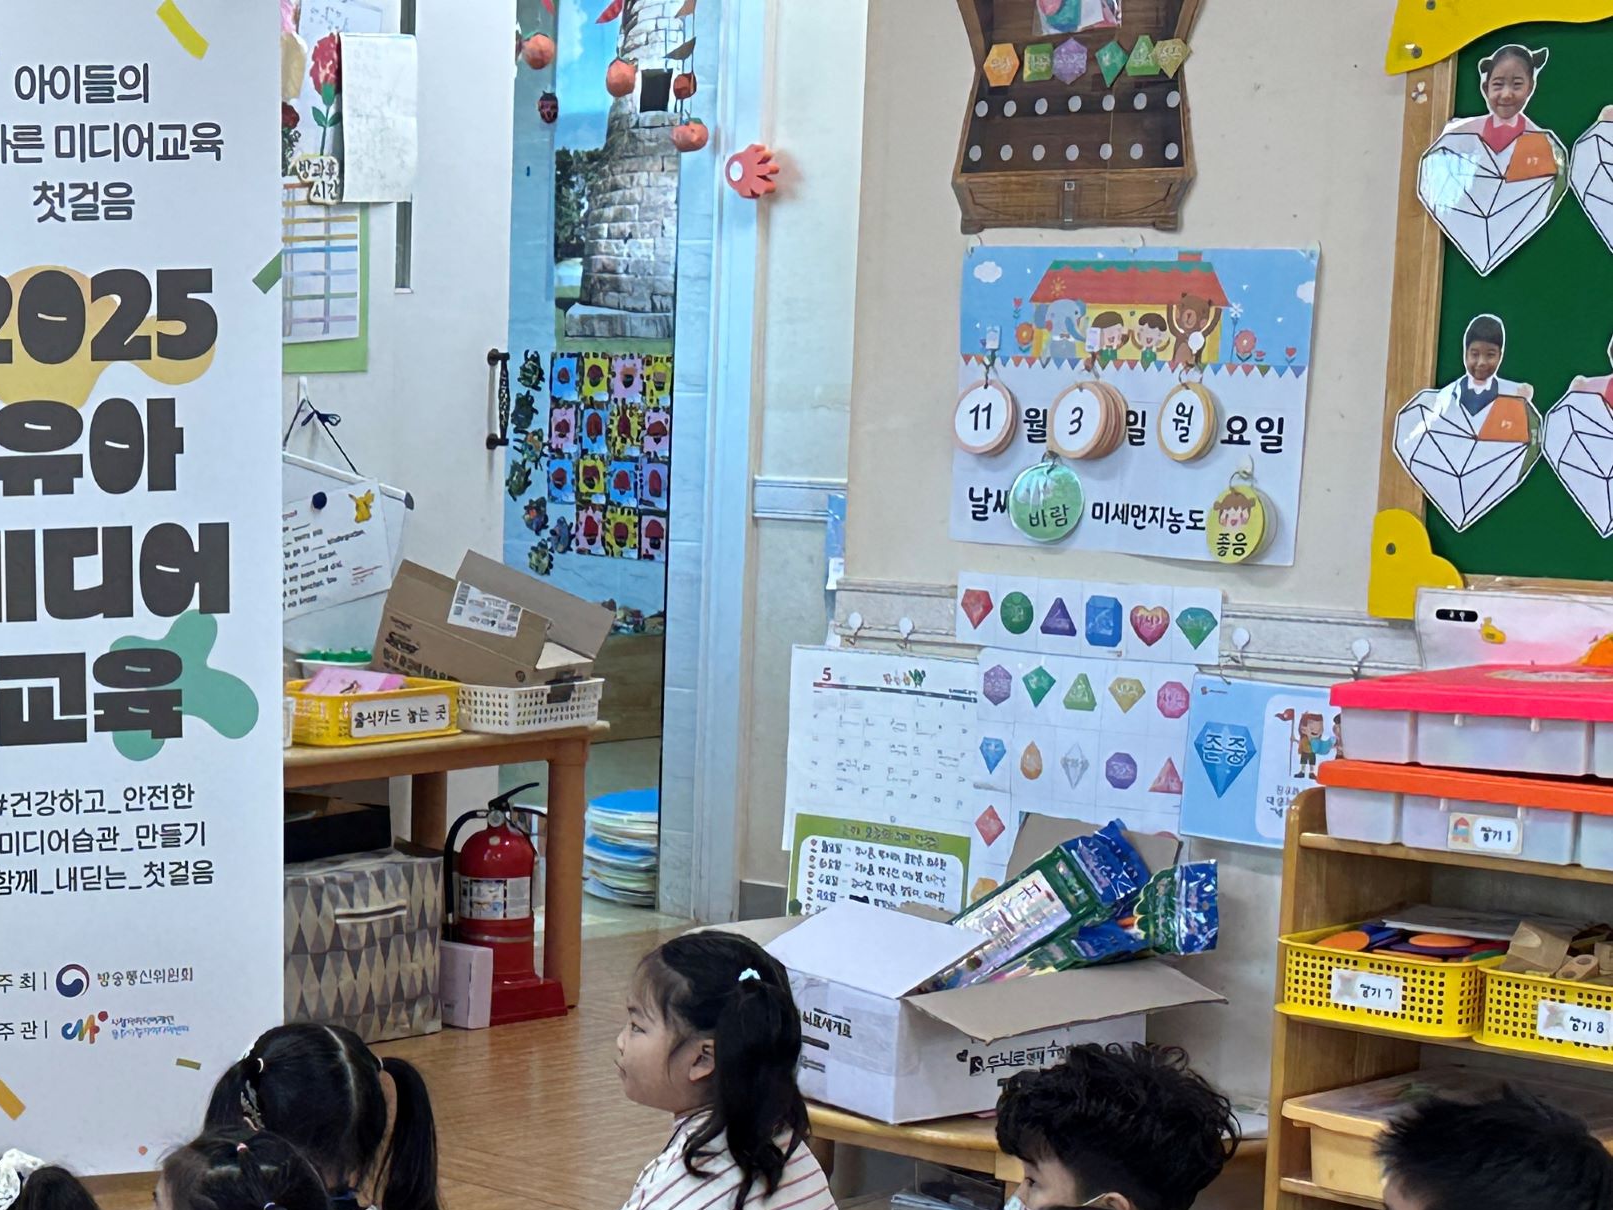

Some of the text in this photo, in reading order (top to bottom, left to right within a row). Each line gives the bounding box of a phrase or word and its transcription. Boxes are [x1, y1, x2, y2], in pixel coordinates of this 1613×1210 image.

[15, 64, 150, 105] 아이들의
[55, 122, 224, 163] 미디어교육
[298, 159, 338, 180] 방과후
[313, 180, 338, 200] 시간
[33, 182, 134, 224] 첫걸음
[969, 402, 992, 431] 11
[1023, 407, 1047, 443] 월
[1069, 406, 1084, 435] 3
[1126, 409, 1147, 446] 일
[1173, 402, 1193, 443] 월
[1028, 505, 1069, 529] 바람
[1216, 533, 1247, 556] 좋음
[822, 668, 832, 682] 5
[1203, 733, 1247, 767] 존중
[98, 967, 193, 987] 방송통신위원회
